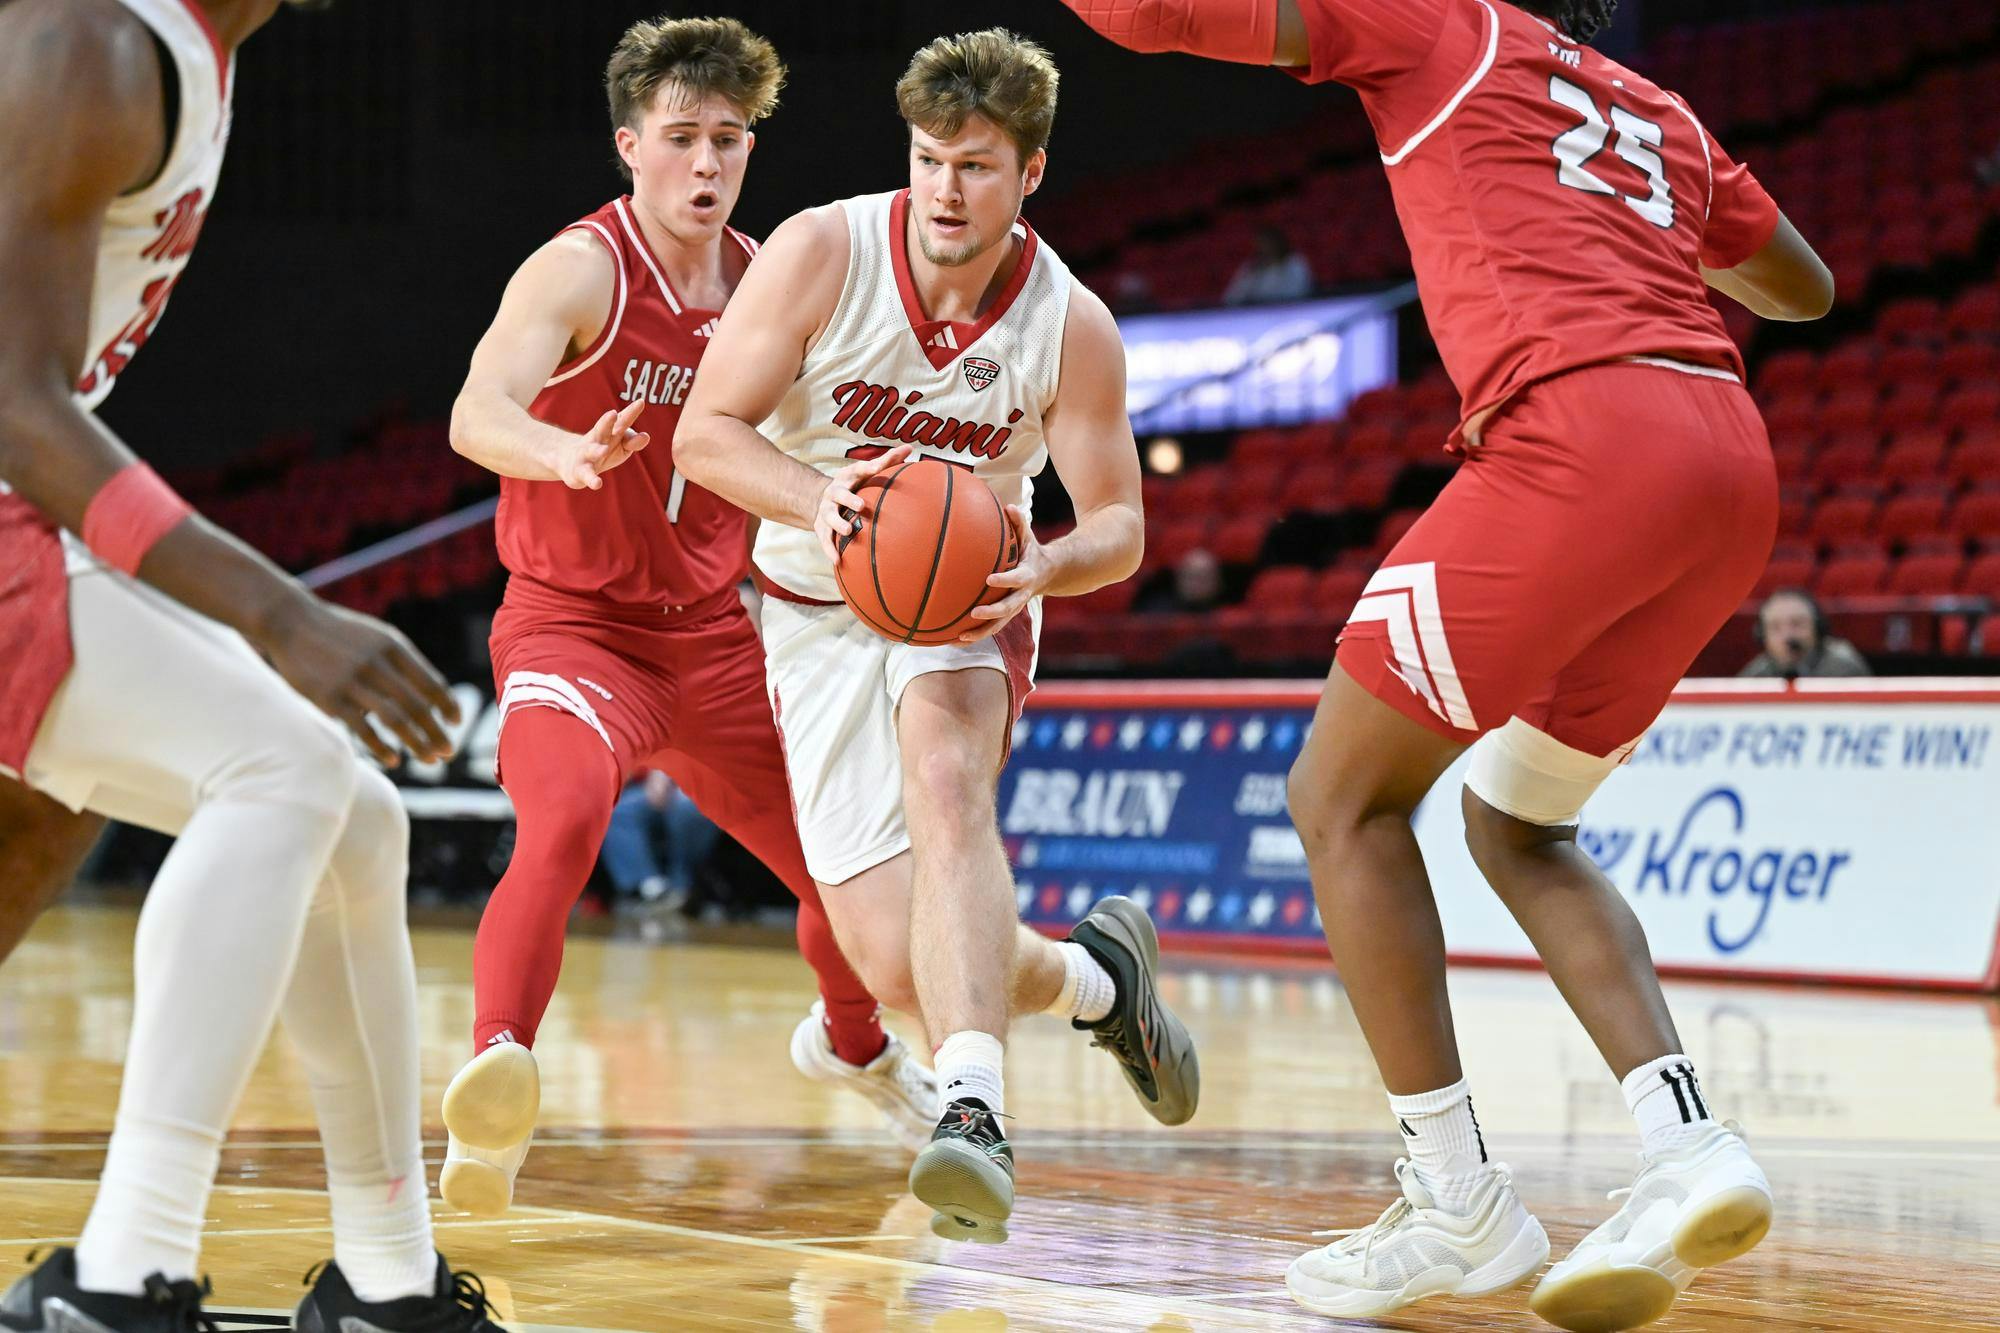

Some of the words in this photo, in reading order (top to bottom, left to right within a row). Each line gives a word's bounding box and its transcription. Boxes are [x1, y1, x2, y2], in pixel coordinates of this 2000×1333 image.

[1548, 73, 1676, 230] 25
[619, 358, 694, 406] SACRE
[966, 366, 997, 380] MAC
[832, 380, 1025, 460] Miami
[1726, 722, 1807, 769] FOR
[1818, 724, 1888, 769] THE
[1901, 722, 1990, 769] WIN!
[1004, 768, 1185, 838] BRAUN
[1635, 785, 1851, 953] Kroger
